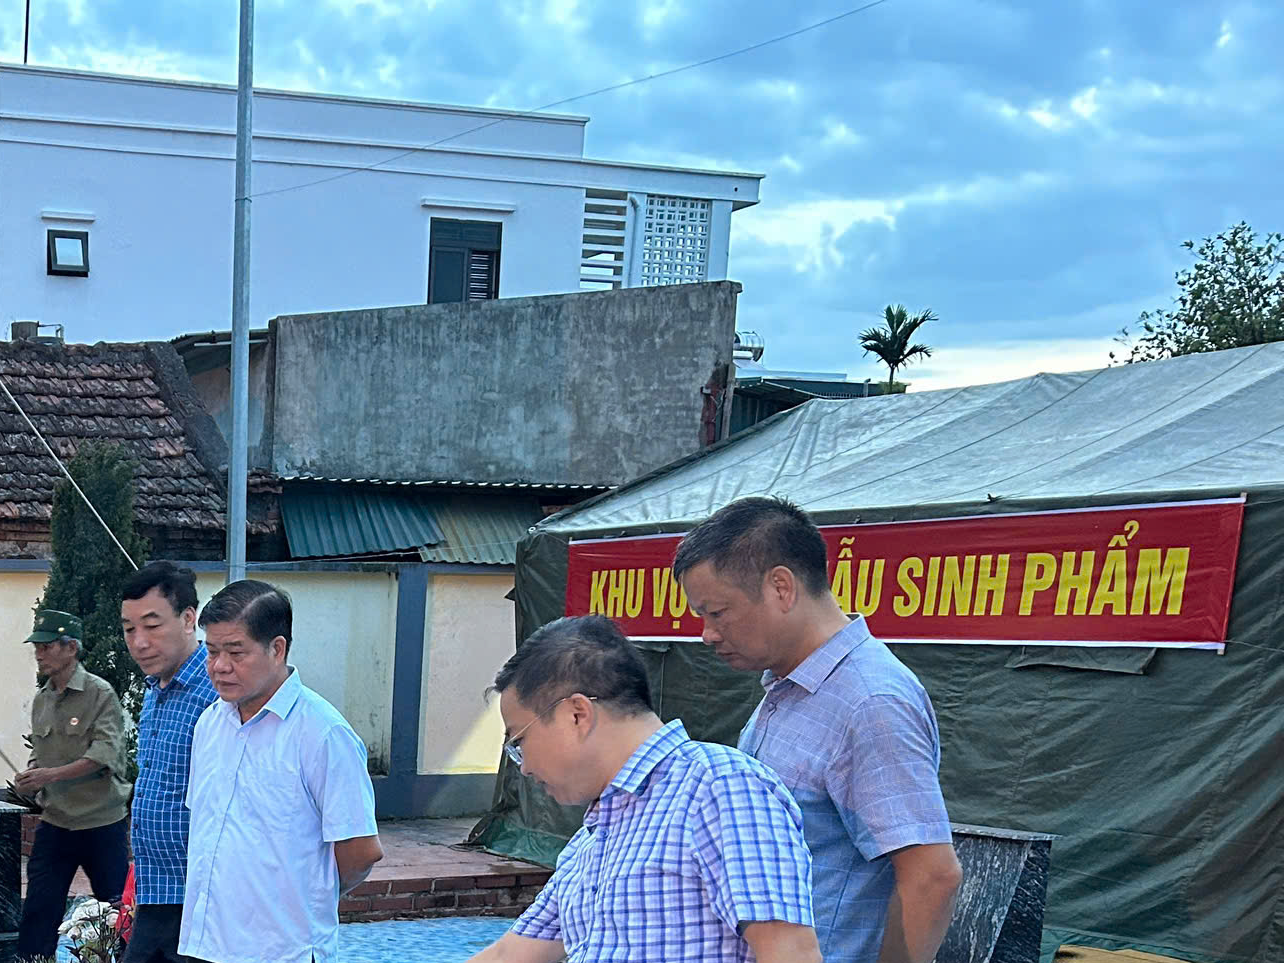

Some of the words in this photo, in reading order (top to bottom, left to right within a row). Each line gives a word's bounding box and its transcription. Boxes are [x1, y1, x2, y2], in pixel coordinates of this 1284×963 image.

[589, 568, 646, 618] KHU
[830, 536, 886, 618] ẪU
[893, 553, 1011, 617] SINH
[1018, 520, 1191, 616] PHẨM
